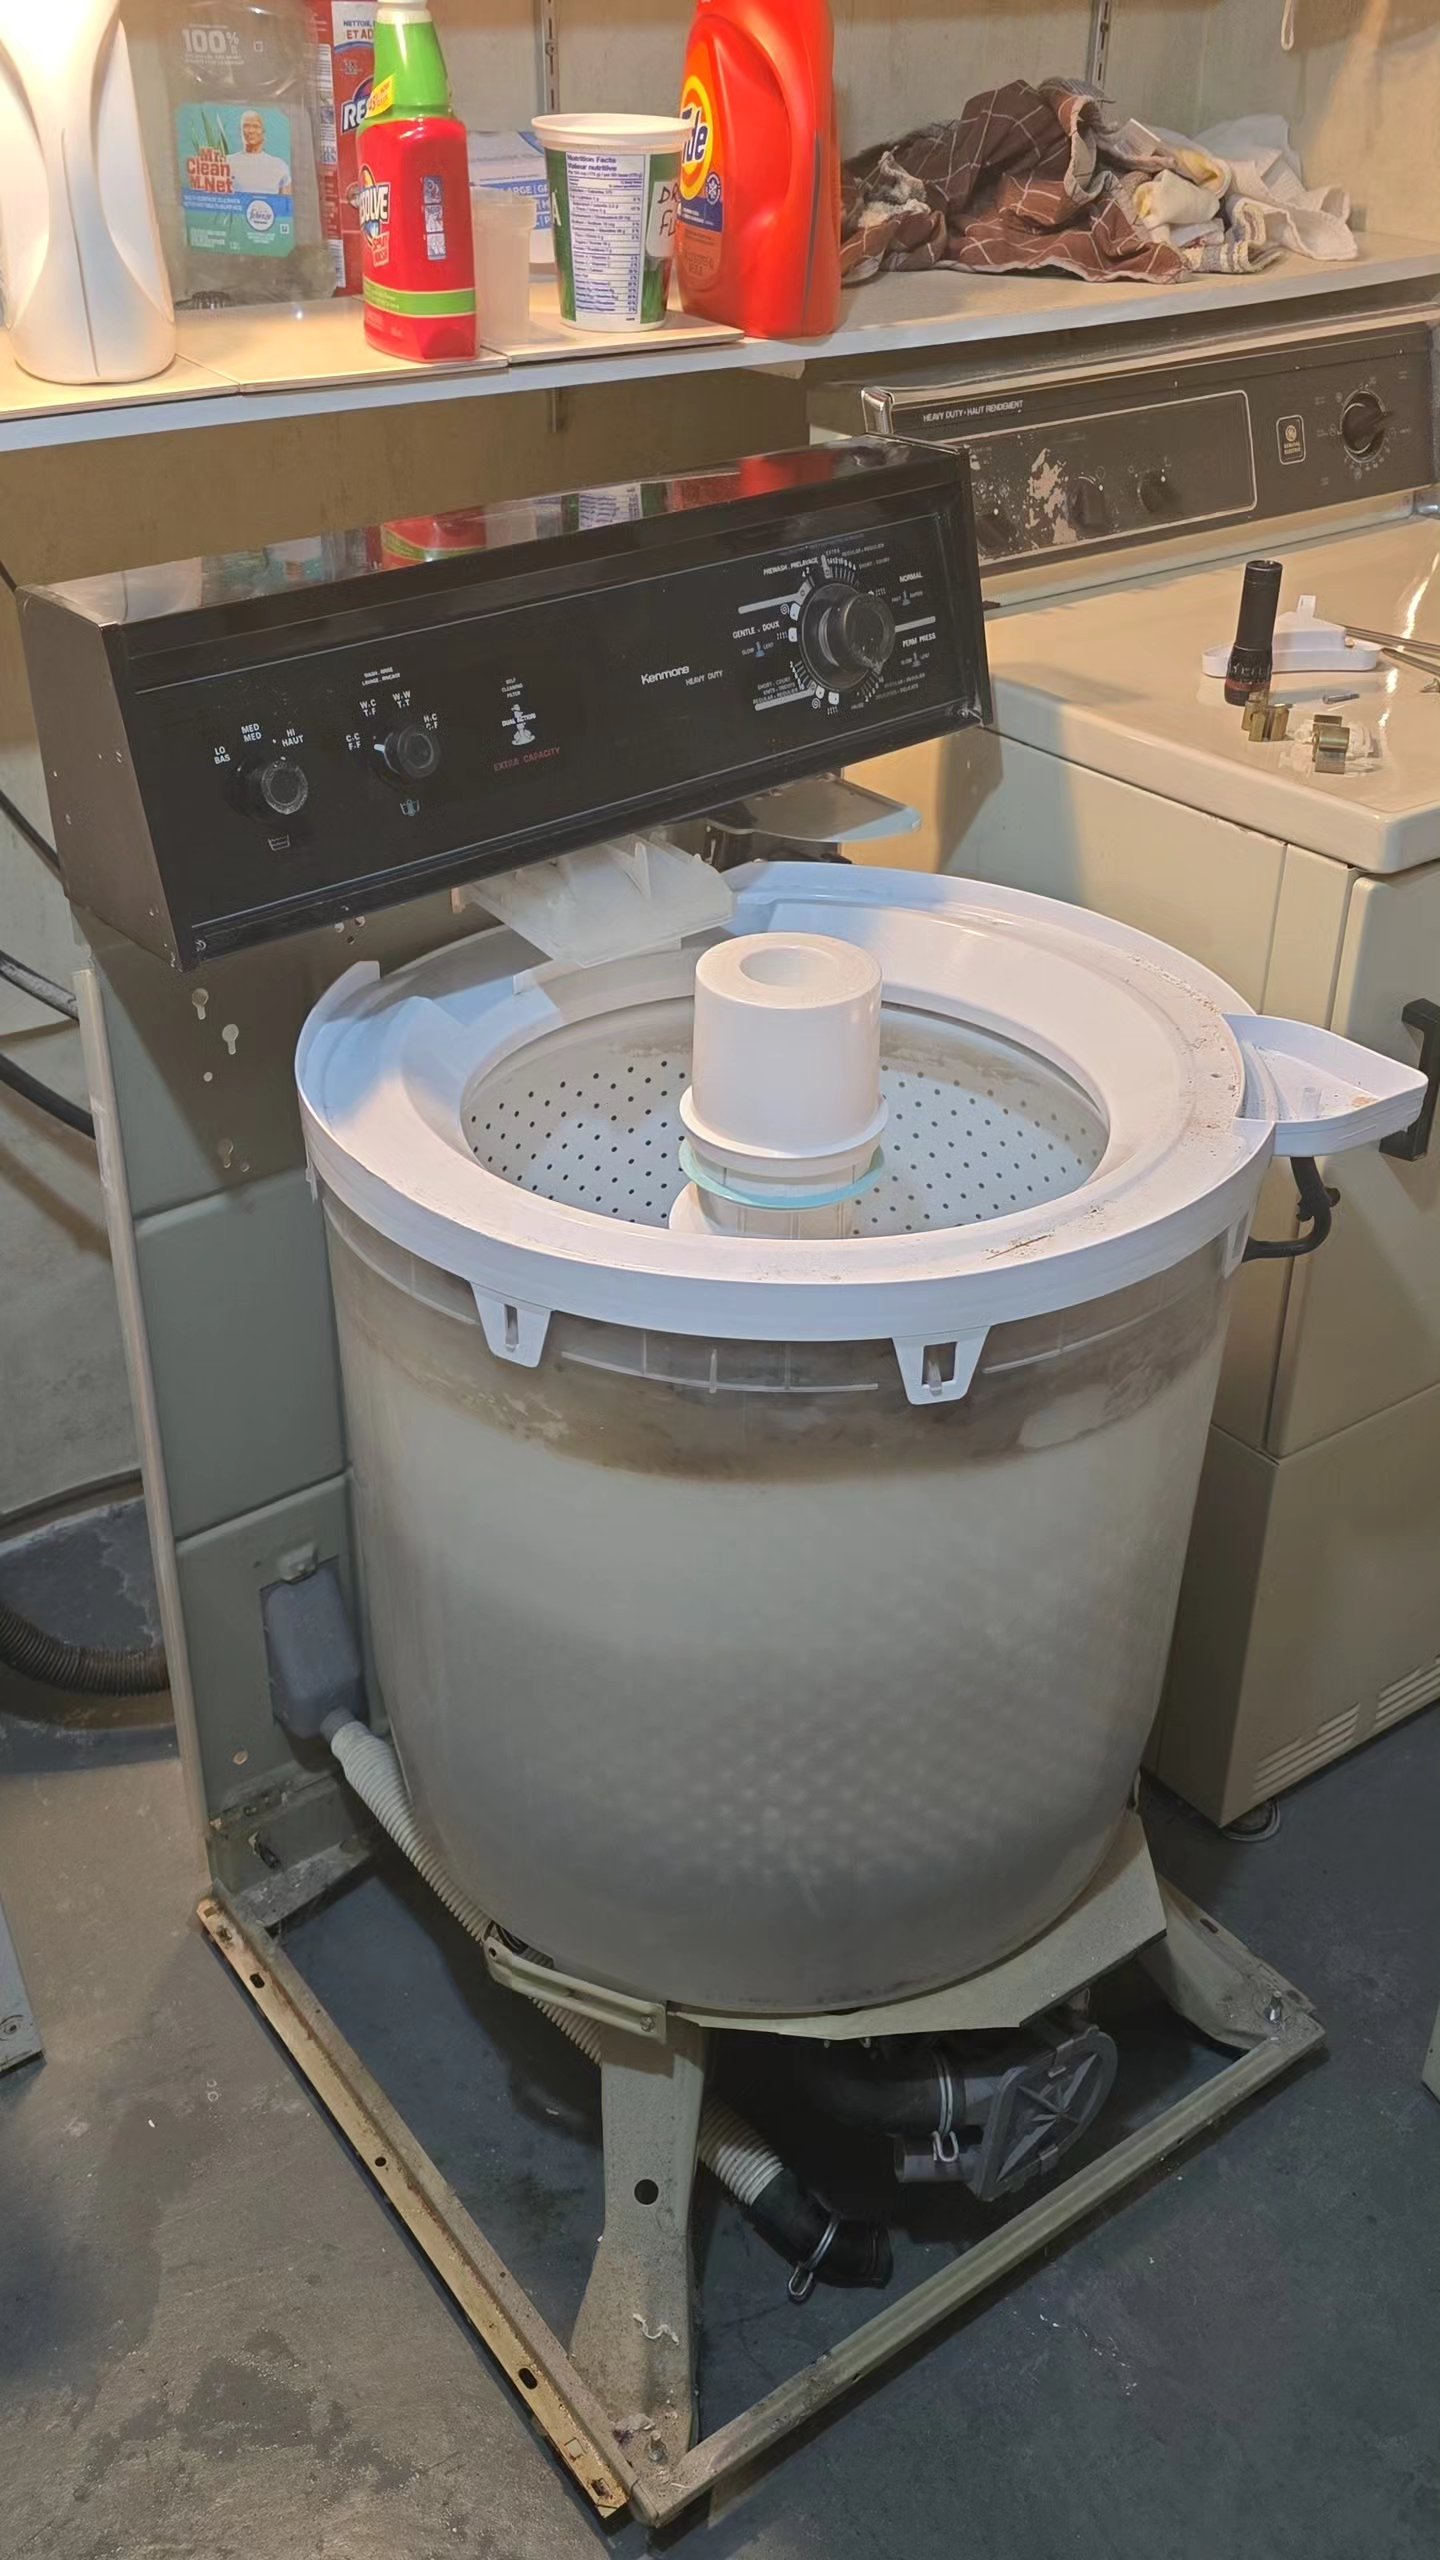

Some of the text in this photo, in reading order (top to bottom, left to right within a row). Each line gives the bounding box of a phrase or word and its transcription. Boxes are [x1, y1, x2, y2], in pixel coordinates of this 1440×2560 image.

[346, 30, 359, 39] ET
[186, 157, 231, 177] Clean
[899, 571, 924, 583] NORMAL
[732, 620, 781, 639] GENTLE DOUX
[640, 665, 690, 686] Kenmore
[707, 669, 724, 680] DUTY
[241, 722, 260, 734] MED
[286, 728, 296, 738] HI
[243, 731, 262, 743] MED
[281, 734, 304, 748] HAUT
[214, 745, 226, 756] LO
[213, 753, 231, 765] BAS
[493, 746, 560, 772] EXTRA CAPACITY
